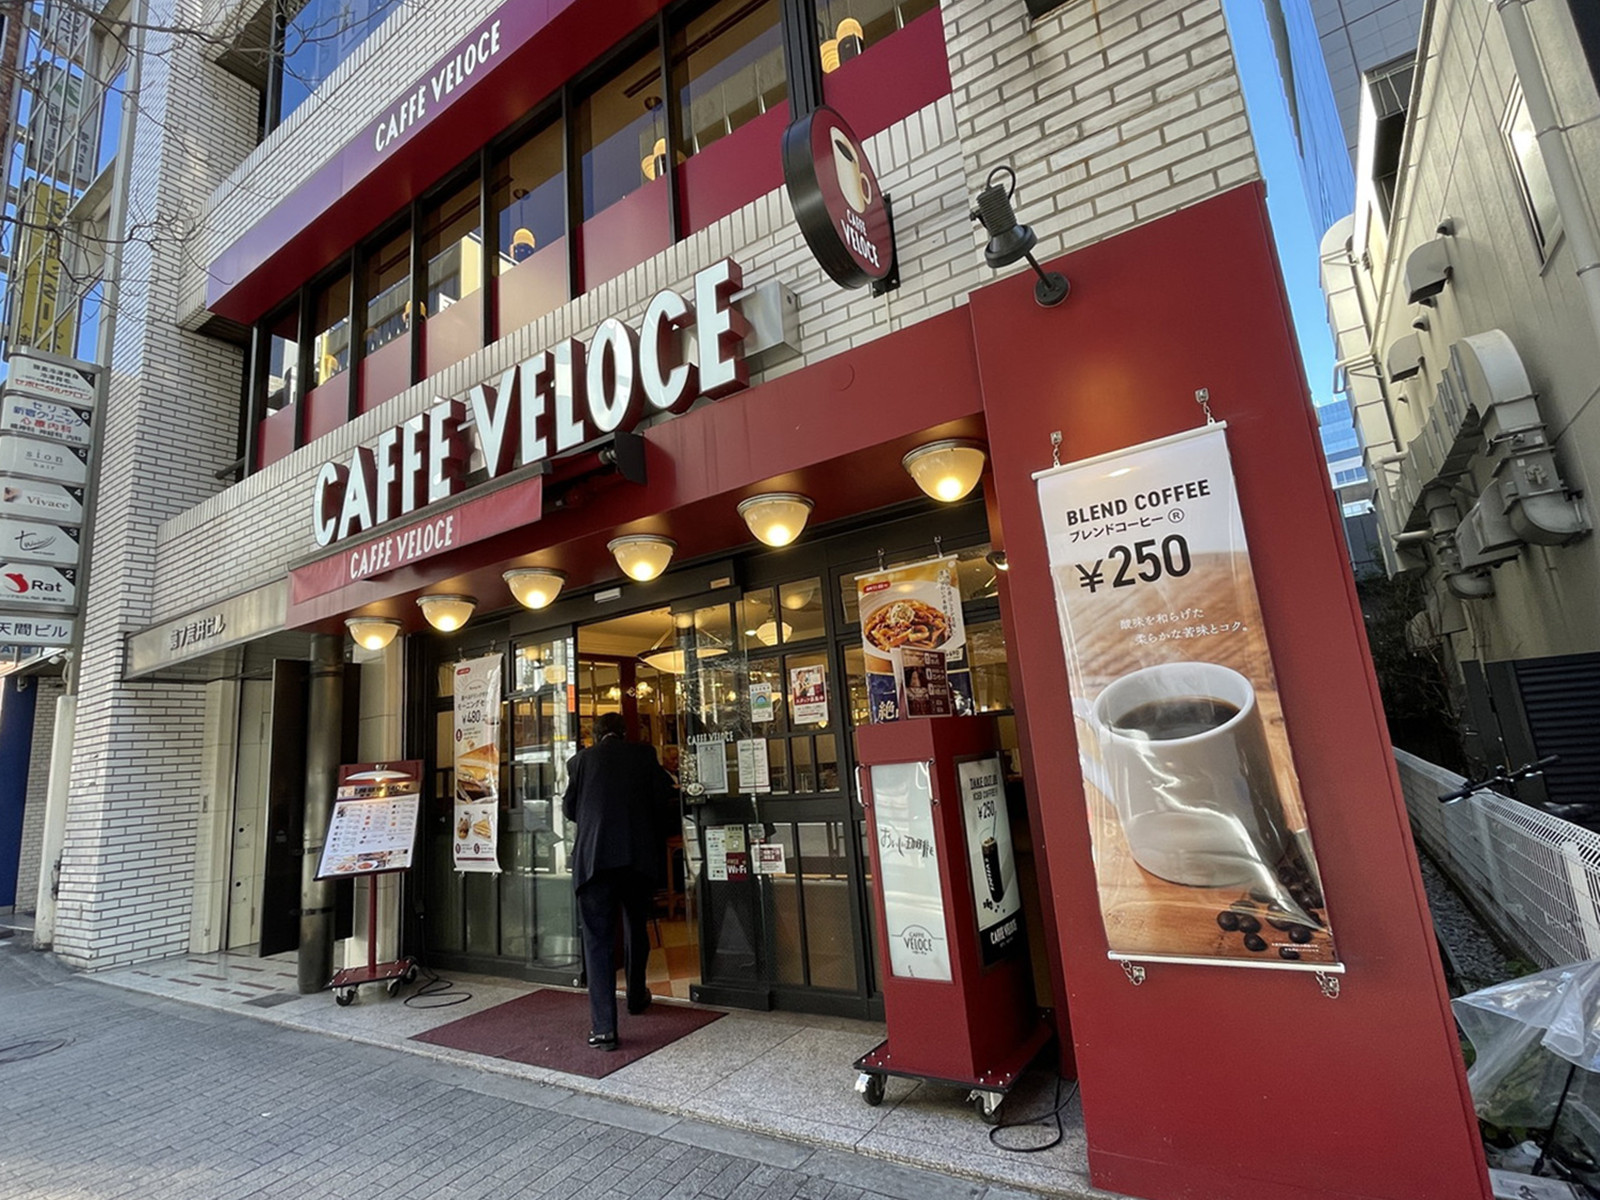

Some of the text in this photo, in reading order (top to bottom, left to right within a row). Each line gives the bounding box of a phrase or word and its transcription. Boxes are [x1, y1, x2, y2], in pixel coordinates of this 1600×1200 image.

[431, 19, 500, 103] VELOCE
[841, 219, 880, 268] VELOCE
[469, 259, 736, 479] VELOCE
[13, 406, 83, 427] 新宿クリニック
[33, 402, 71, 417] セリエ
[81, 411, 89, 420] 6
[20, 417, 72, 433] 心療内科
[26, 449, 63, 463] sion
[78, 449, 86, 457] 5
[33, 462, 55, 470] hair
[27, 496, 69, 509] Vivace
[1066, 479, 1211, 526] BLEND COFFEE
[69, 528, 77, 537] 3
[1069, 517, 1164, 543] ブレンドコーヒー
[396, 515, 453, 562] VELOCE
[1075, 534, 1192, 593] ¥250
[65, 570, 74, 579] 2
[32, 580, 62, 593] Rat
[1119, 608, 1205, 631] 酸味を和らげた
[728, 864, 747, 874] Wi-Fi
[903, 937, 933, 952] VELOCE
